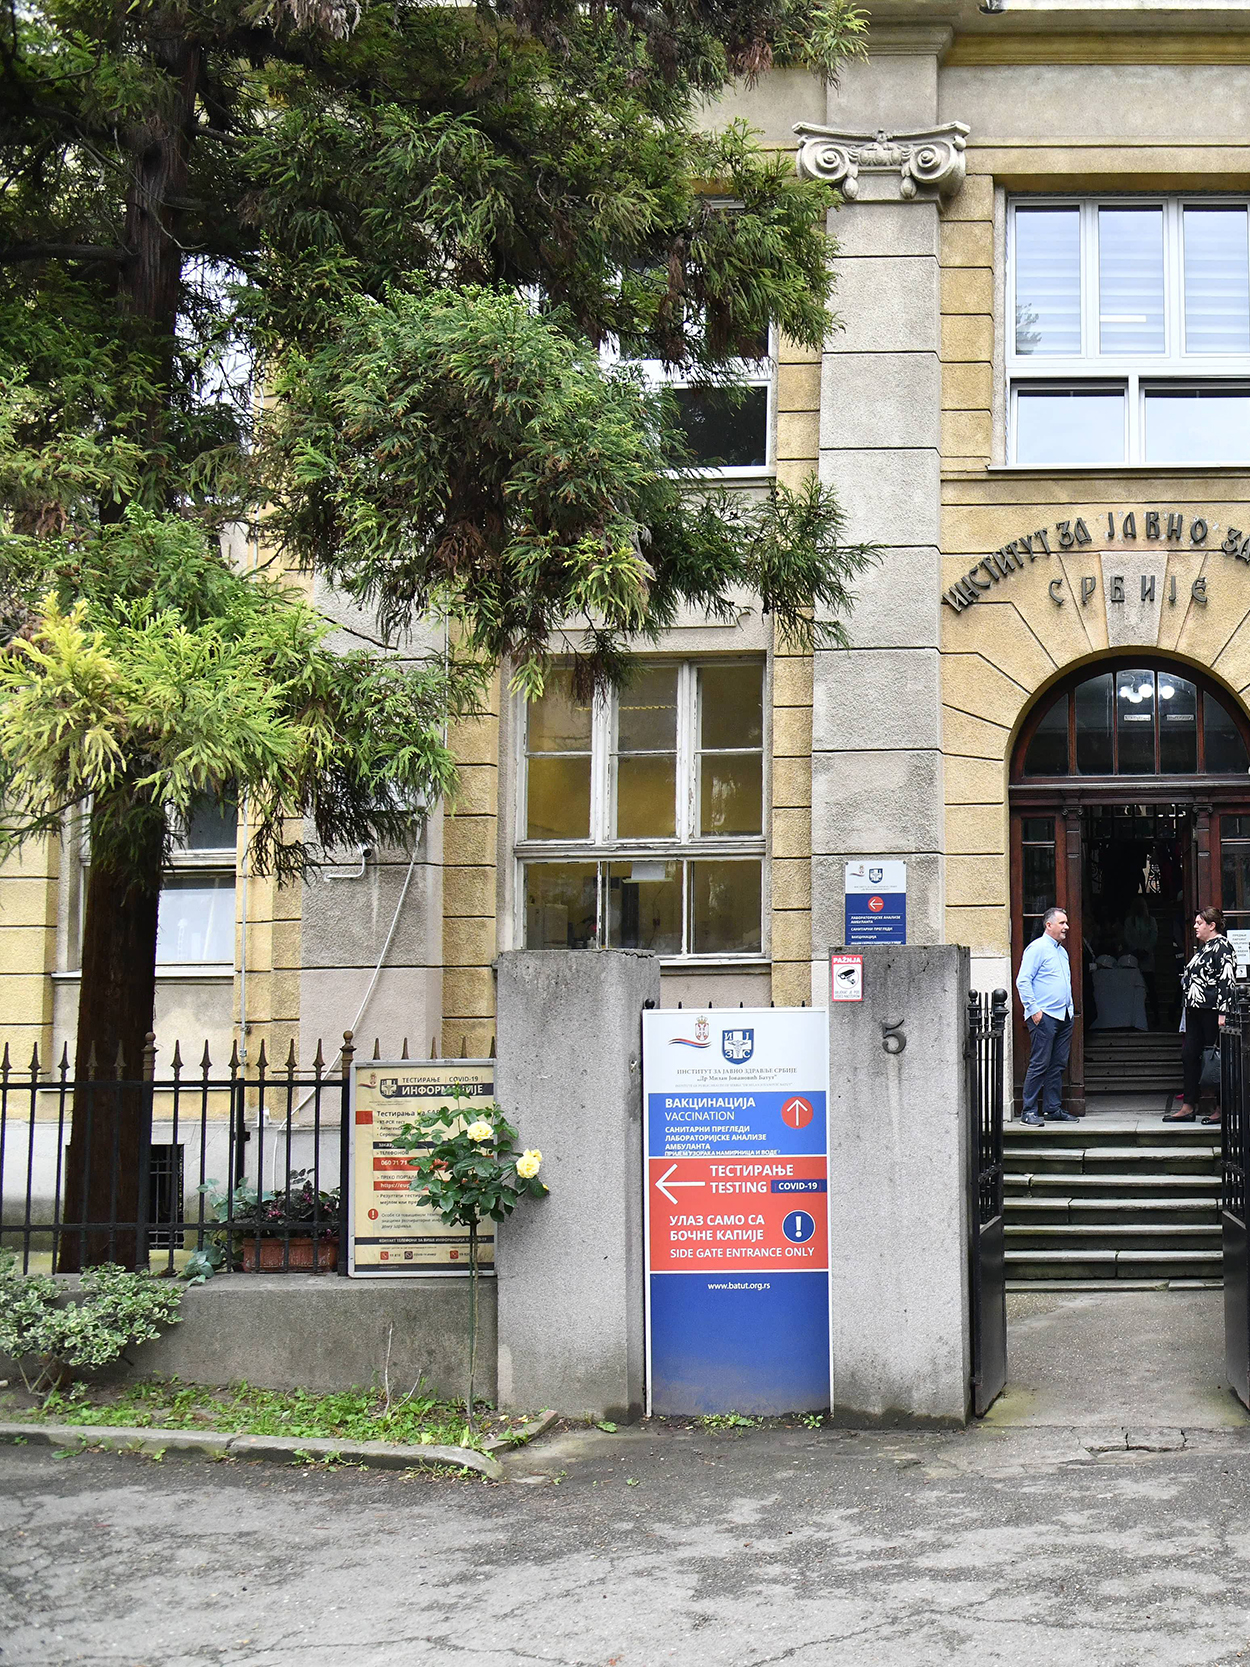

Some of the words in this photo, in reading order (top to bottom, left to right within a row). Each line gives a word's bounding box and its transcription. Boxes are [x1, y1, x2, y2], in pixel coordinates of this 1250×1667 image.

[942, 528, 1052, 613] ИНСТИТУТ
[1055, 517, 1093, 548] ЗА
[1103, 510, 1209, 542] ЈАВНО
[1048, 574, 1209, 606] СРБИЈЕ
[880, 1018, 907, 1054] 5
[665, 1097, 756, 1109] ВАКЦИНАЦИЈА
[665, 1111, 735, 1121] VACCINATION
[665, 1134, 730, 1142] ЛАБОРАТОРИЈСКЕ
[710, 1164, 794, 1176] ТЕСТИРАЊЕ
[710, 1182, 767, 1194] TESTING
[670, 1215, 704, 1226] УЛАЗ
[707, 1215, 745, 1225] САМО
[748, 1215, 765, 1225] СА
[670, 1230, 713, 1241] БОЧНЕ
[717, 1230, 764, 1242] КАПИЈЕ
[670, 1249, 693, 1258] SIDE
[696, 1248, 723, 1258] GATE
[726, 1248, 782, 1258] ENTRANCE
[785, 1247, 815, 1257] ONLY
[708, 1282, 770, 1290] www.batut.org.rs
